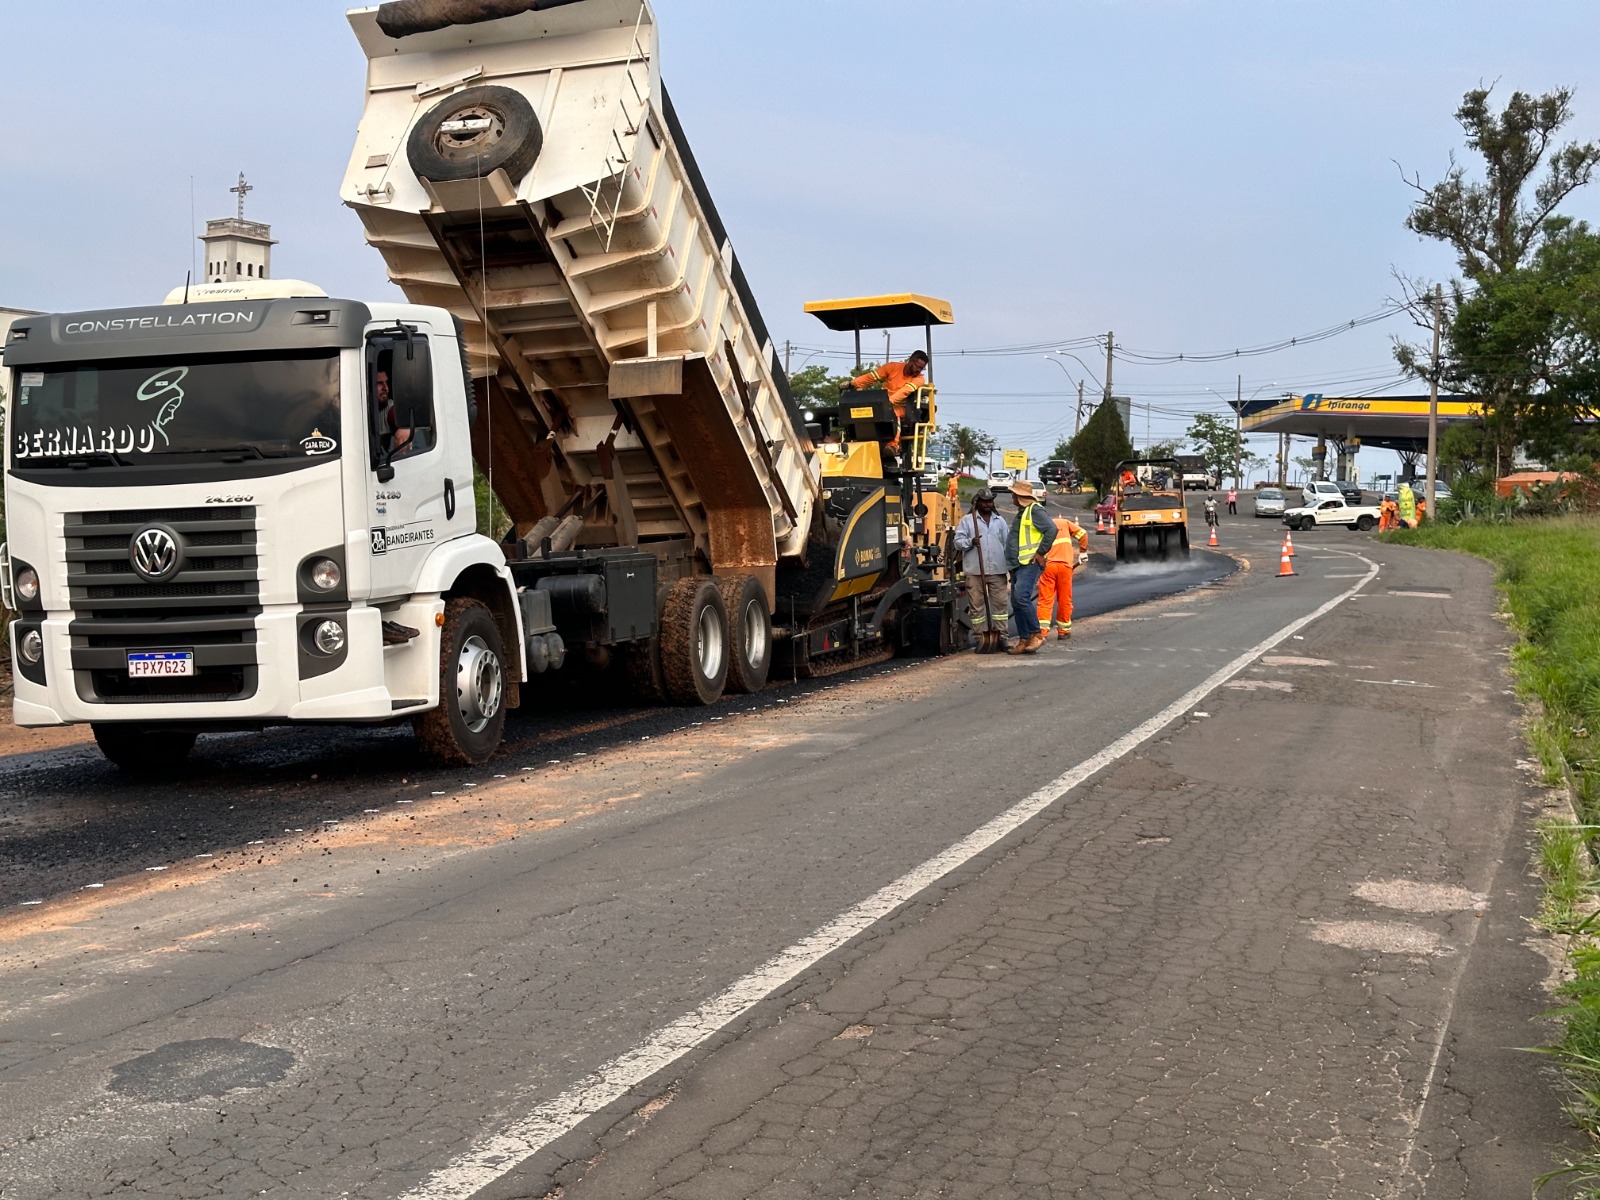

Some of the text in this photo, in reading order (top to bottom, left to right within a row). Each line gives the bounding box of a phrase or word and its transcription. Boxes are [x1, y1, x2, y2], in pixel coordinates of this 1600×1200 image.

[65, 311, 254, 334] CONSTELLATION
[1327, 401, 1371, 410] Ipiranga
[15, 424, 155, 459] BERNARDO
[386, 529, 435, 546] BANDEIRANTES
[135, 660, 186, 675] FPX7G23
